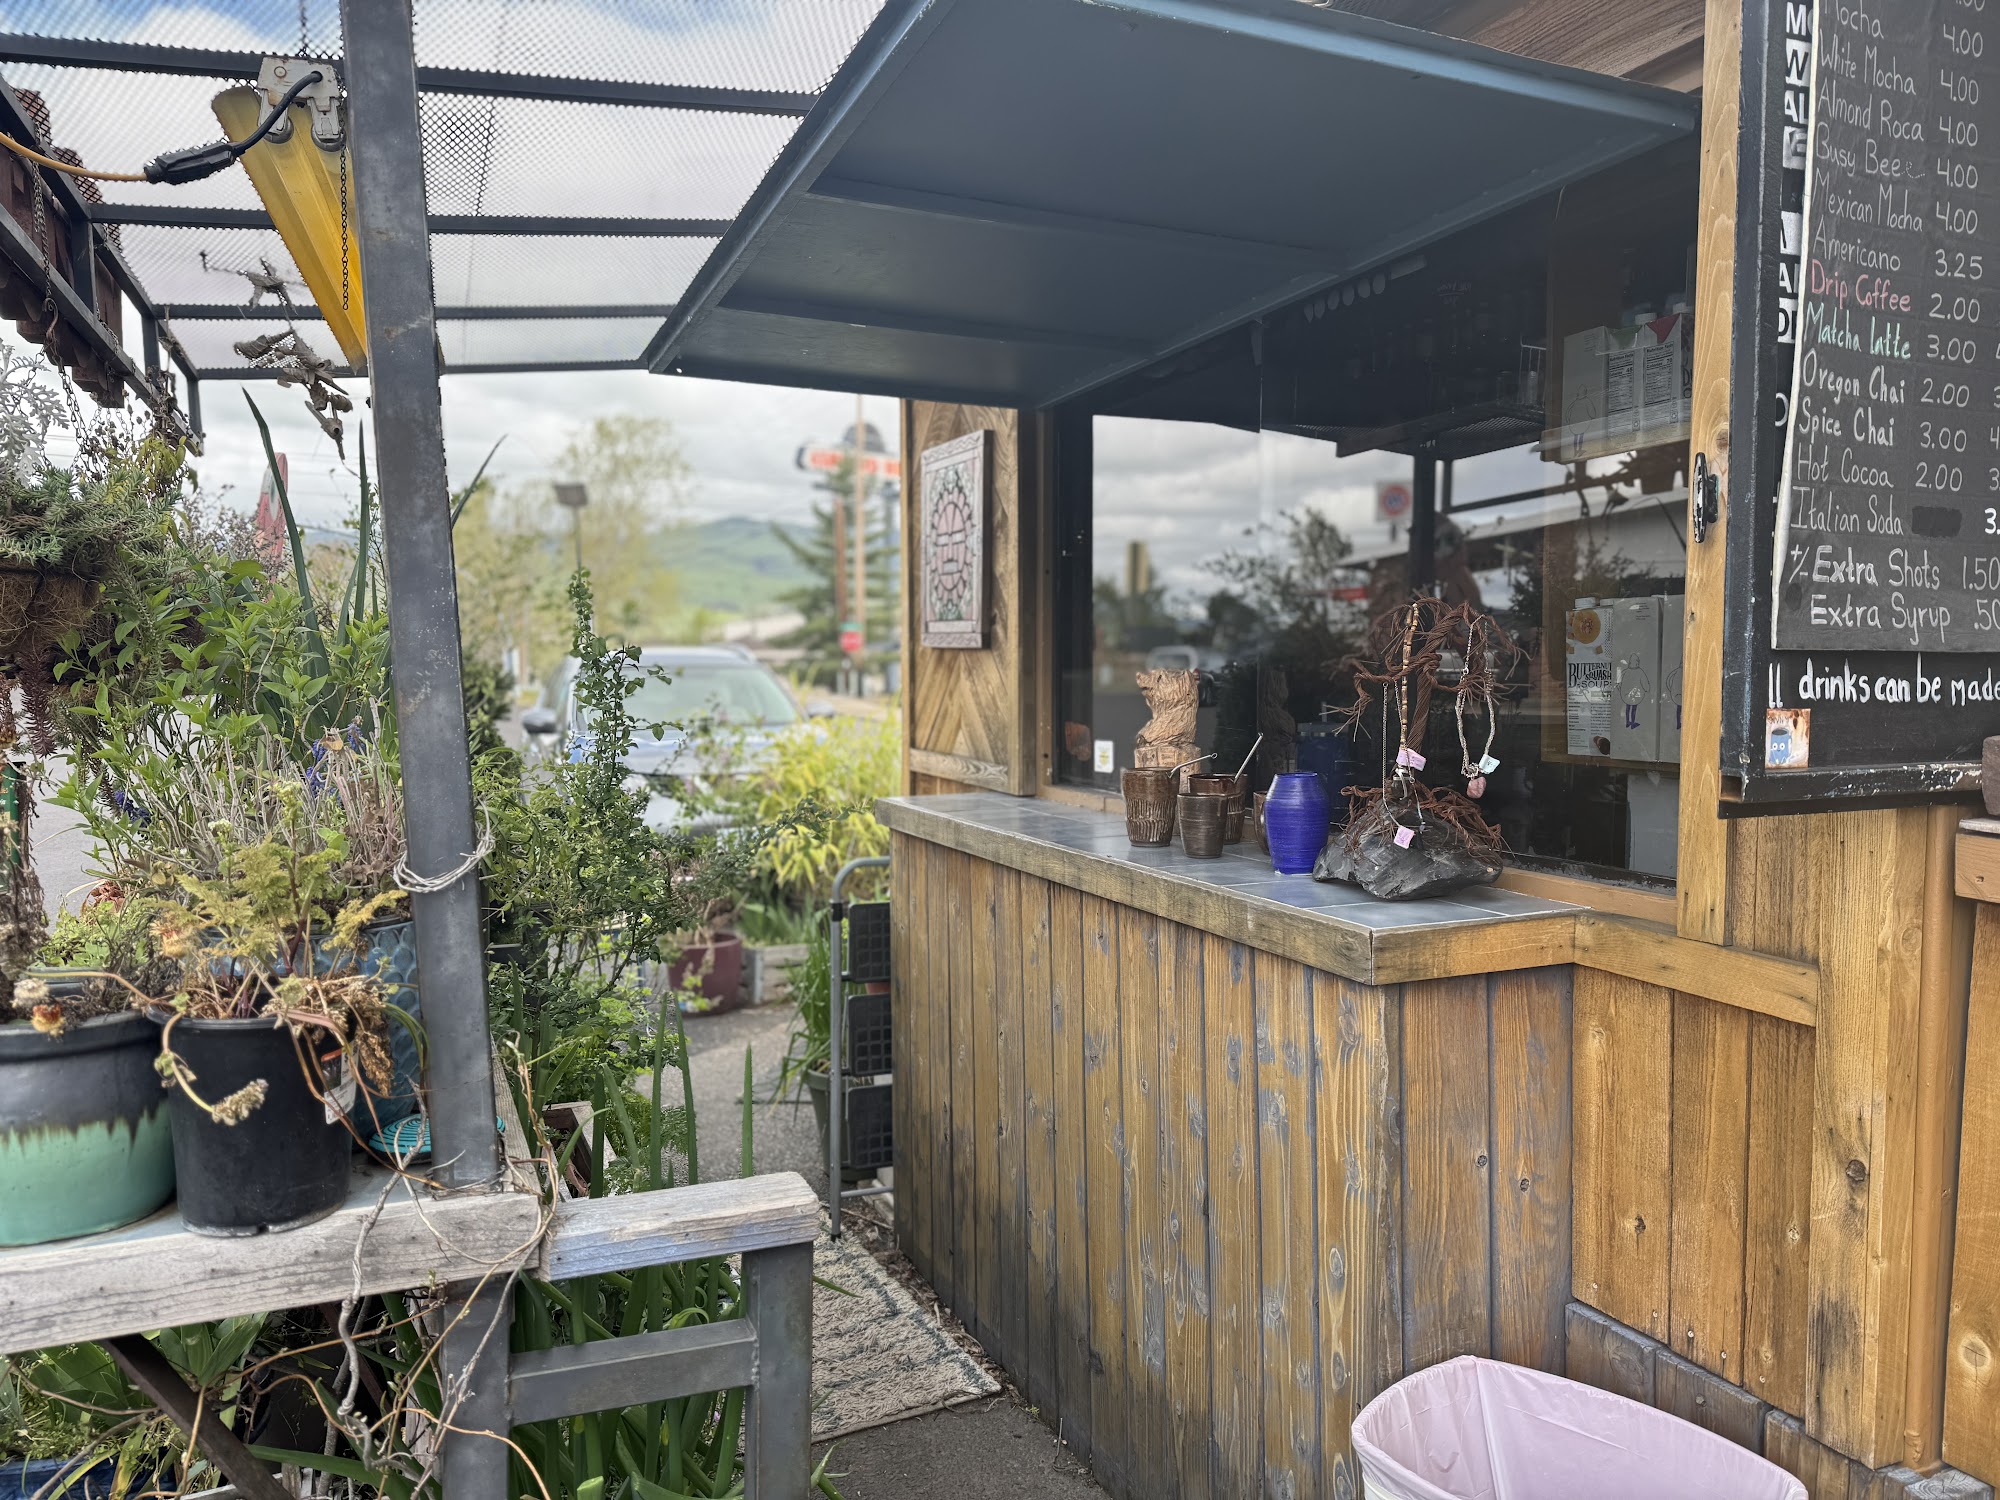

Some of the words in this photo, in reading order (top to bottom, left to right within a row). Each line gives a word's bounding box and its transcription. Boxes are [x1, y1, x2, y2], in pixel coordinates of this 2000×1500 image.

[1819, 28, 1857, 79] White
[1864, 45, 1916, 95] Mocha
[1940, 68, 1979, 105] 4.00
[1943, 23, 1983, 57] 4.00
[1817, 77, 1872, 130] Almond
[1880, 99, 1924, 142] Roca
[1939, 115, 1979, 147] 4.00
[1816, 121, 1856, 177] Busy
[1865, 138, 1902, 177] Bee
[1937, 157, 1979, 189] 4.00
[1812, 167, 1873, 223] Mexican
[1878, 183, 1923, 232] Mocha
[1935, 201, 1979, 235] 4.00
[1812, 215, 1901, 271] Americano
[1935, 248, 1983, 280] 3.25
[1811, 259, 1848, 309] Drip
[1856, 274, 1911, 312] Coffee
[1929, 293, 1981, 323] 2.00
[1803, 301, 1862, 352] Matcha
[1926, 334, 1977, 364] 3.00
[1802, 348, 1860, 404] Oregon
[1869, 365, 1905, 404] Chai
[1921, 378, 1970, 408] 2.00
[1799, 396, 1841, 444] Spice
[1853, 407, 1894, 446] Chai
[1920, 421, 1967, 452] 3.00
[1798, 442, 1829, 482] Hot
[1841, 447, 1894, 489] Cocoa
[1915, 462, 1963, 491] 2.00
[1790, 486, 1860, 533] Italian
[1867, 494, 1904, 536] Soda
[1812, 545, 1879, 587] Extra
[1888, 547, 1940, 590] Shots
[1963, 555, 2000, 590] 1.50
[1810, 594, 1882, 629] Extra
[1891, 591, 1950, 646] Syrup
[1585, 669, 1612, 681] SQUASH
[1799, 657, 1870, 703] drinks
[1874, 675, 1911, 703] can
[1917, 652, 1942, 703] be
[1951, 667, 2000, 706] made
